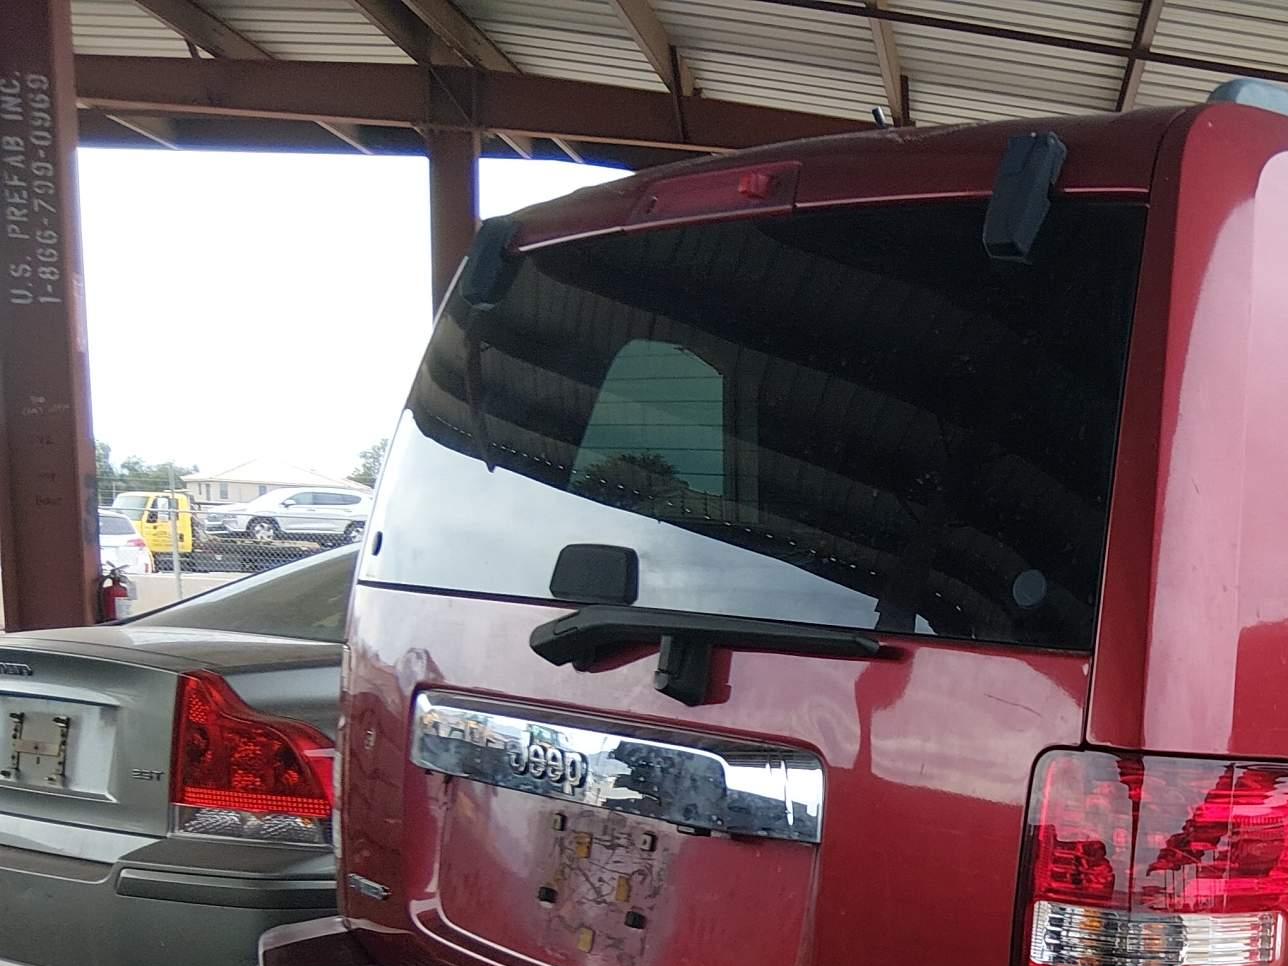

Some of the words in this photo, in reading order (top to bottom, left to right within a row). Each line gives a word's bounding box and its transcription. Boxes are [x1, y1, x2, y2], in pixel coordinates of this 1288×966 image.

[0, 71, 24, 121] INC.
[2, 136, 30, 239] PREFAB
[25, 74, 62, 303] 1-866-799-0969
[9, 255, 33, 305] U.S.
[507, 739, 587, 796] Jeep
